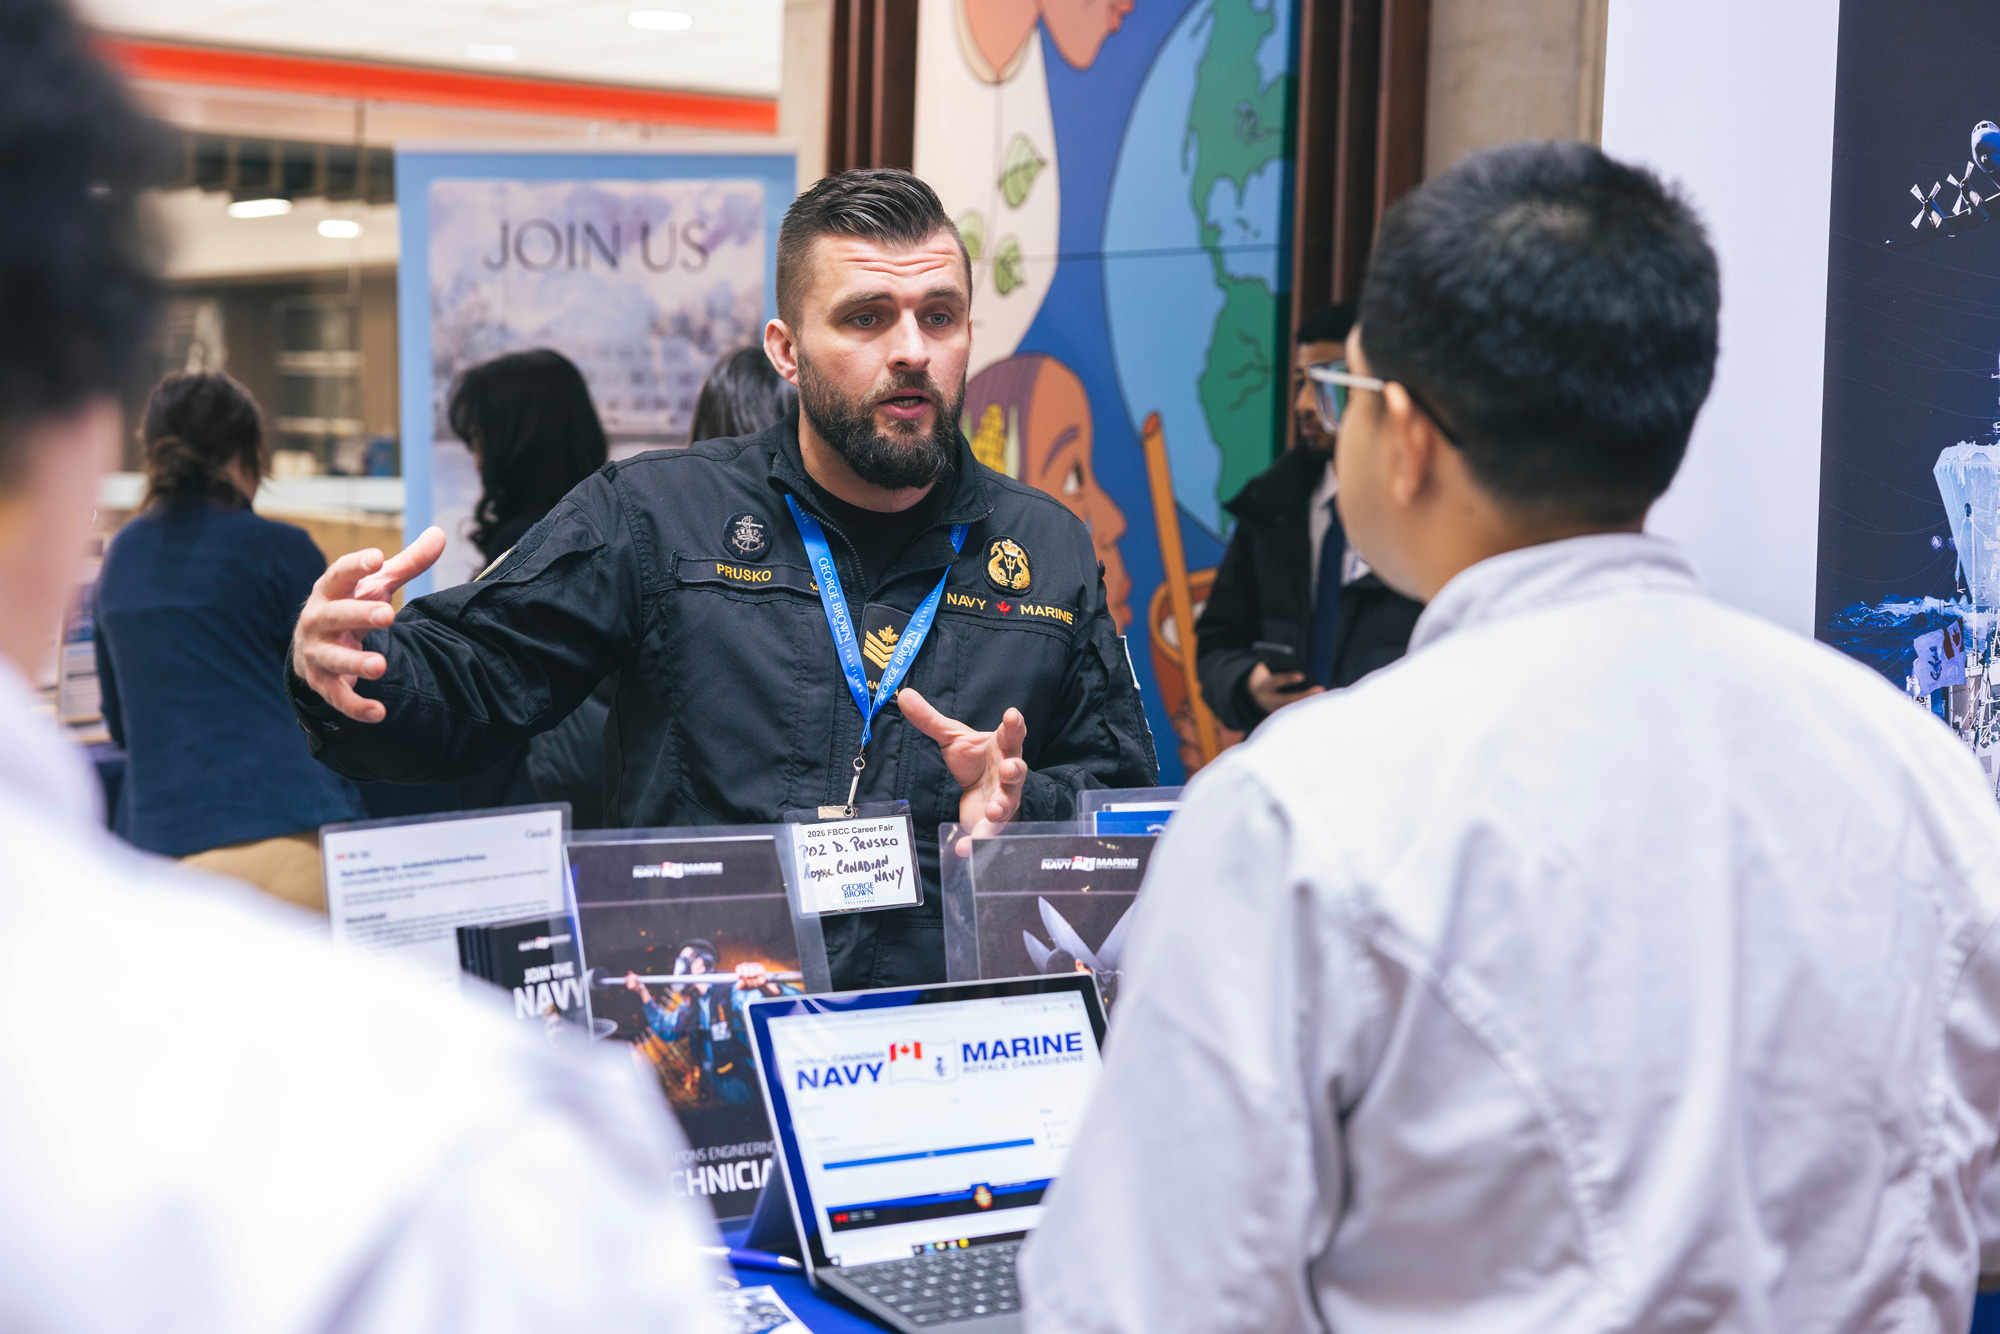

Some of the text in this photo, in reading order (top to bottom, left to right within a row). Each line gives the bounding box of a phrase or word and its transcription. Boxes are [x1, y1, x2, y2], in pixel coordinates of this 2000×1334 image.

[482, 217, 710, 273] JOIN US
[716, 563, 772, 583] PRUSKO
[818, 557, 852, 643] GEORGE BROWN
[946, 592, 1074, 626] NAVY MARINE
[877, 629, 918, 706] GEORGE BROWN
[807, 823, 894, 838] 2026 FBCC Career Fair
[1041, 860, 1072, 870] NAVY
[1096, 858, 1139, 867] MARINE
[841, 881, 875, 892] GEORGE
[874, 866, 905, 890] NAVY
[844, 889, 874, 899] BROWN
[524, 961, 574, 984] JOIN THE
[513, 976, 587, 1019] NAVY
[962, 1031, 1083, 1062] MARINE
[797, 1061, 884, 1091] NAVY
